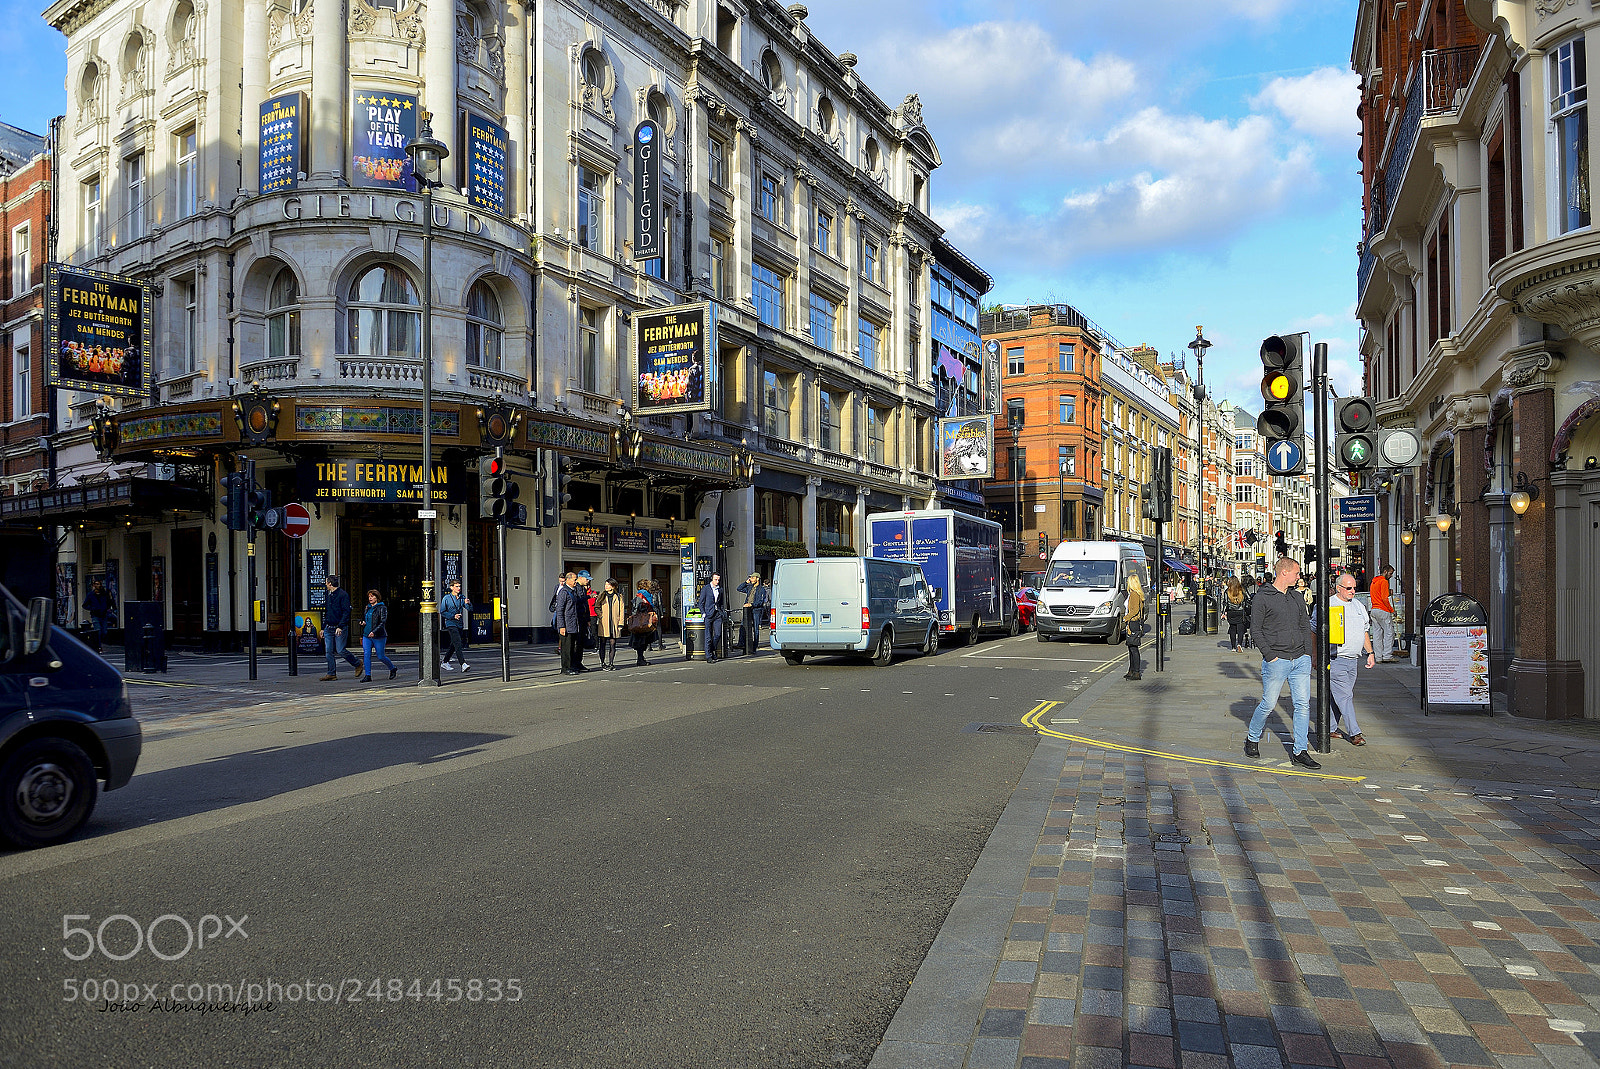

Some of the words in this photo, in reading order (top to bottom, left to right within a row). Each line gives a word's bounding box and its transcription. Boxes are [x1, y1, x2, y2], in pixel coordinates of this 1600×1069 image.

[261, 106, 296, 126] FERRYMAN
[370, 123, 381, 131] OF
[383, 122, 400, 133] THE
[487, 126, 495, 134] THE
[472, 126, 506, 152] FERRYMAN
[640, 145, 652, 247] GIELGUD
[282, 194, 483, 235] GIELGUD
[635, 247, 657, 256] THEATRE
[94, 282, 109, 293] THE
[63, 287, 138, 314] FERRYMAN
[69, 309, 81, 318] JEZ
[84, 311, 132, 327] BUTTERWORTH
[665, 315, 677, 325] THE
[77, 324, 94, 334] SAM
[96, 327, 125, 339] MENDES
[644, 322, 698, 342] FERRYMAN
[647, 345, 657, 354] JEZ
[658, 341, 694, 353] BUTTERWORTH
[653, 357, 666, 366] SAM
[667, 355, 688, 365] MENDES
[988, 353, 998, 409] QUEENS
[945, 428, 986, 440] Misérables
[959, 424, 970, 432] Les
[316, 463, 348, 481] THE
[315, 488, 329, 497] JEZ
[332, 488, 386, 498] BUTTERWORTH
[397, 490, 414, 498] SAM
[416, 490, 448, 499] MDES
[1431, 610, 1479, 623] Concerto
